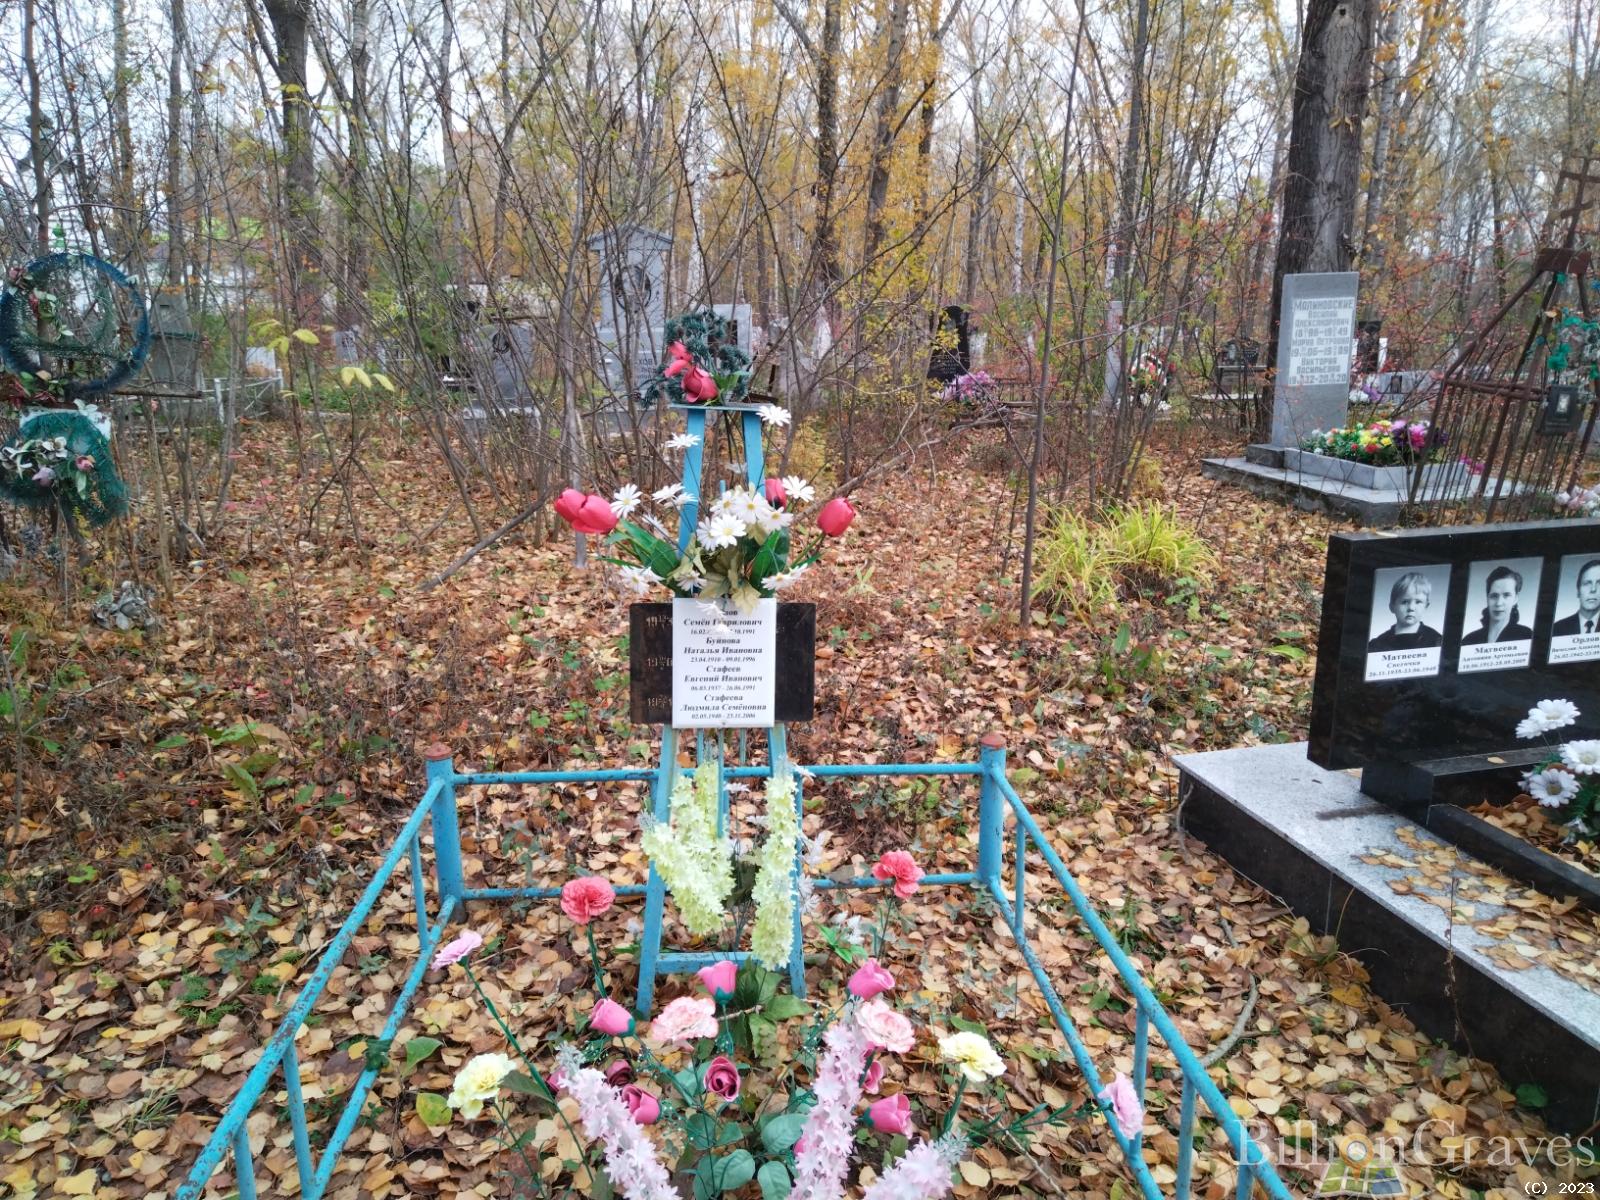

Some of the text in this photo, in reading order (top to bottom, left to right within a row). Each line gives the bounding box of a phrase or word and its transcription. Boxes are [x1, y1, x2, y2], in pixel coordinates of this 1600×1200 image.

[683, 617, 710, 626] Семён
[683, 646, 763, 654] Наталья Ивановна
[1474, 645, 1518, 654] Матвеева
[1381, 652, 1427, 662] Матвеева
[684, 674, 763, 683] Евгений Иванович
[680, 703, 767, 712] Людмила Семёновна
